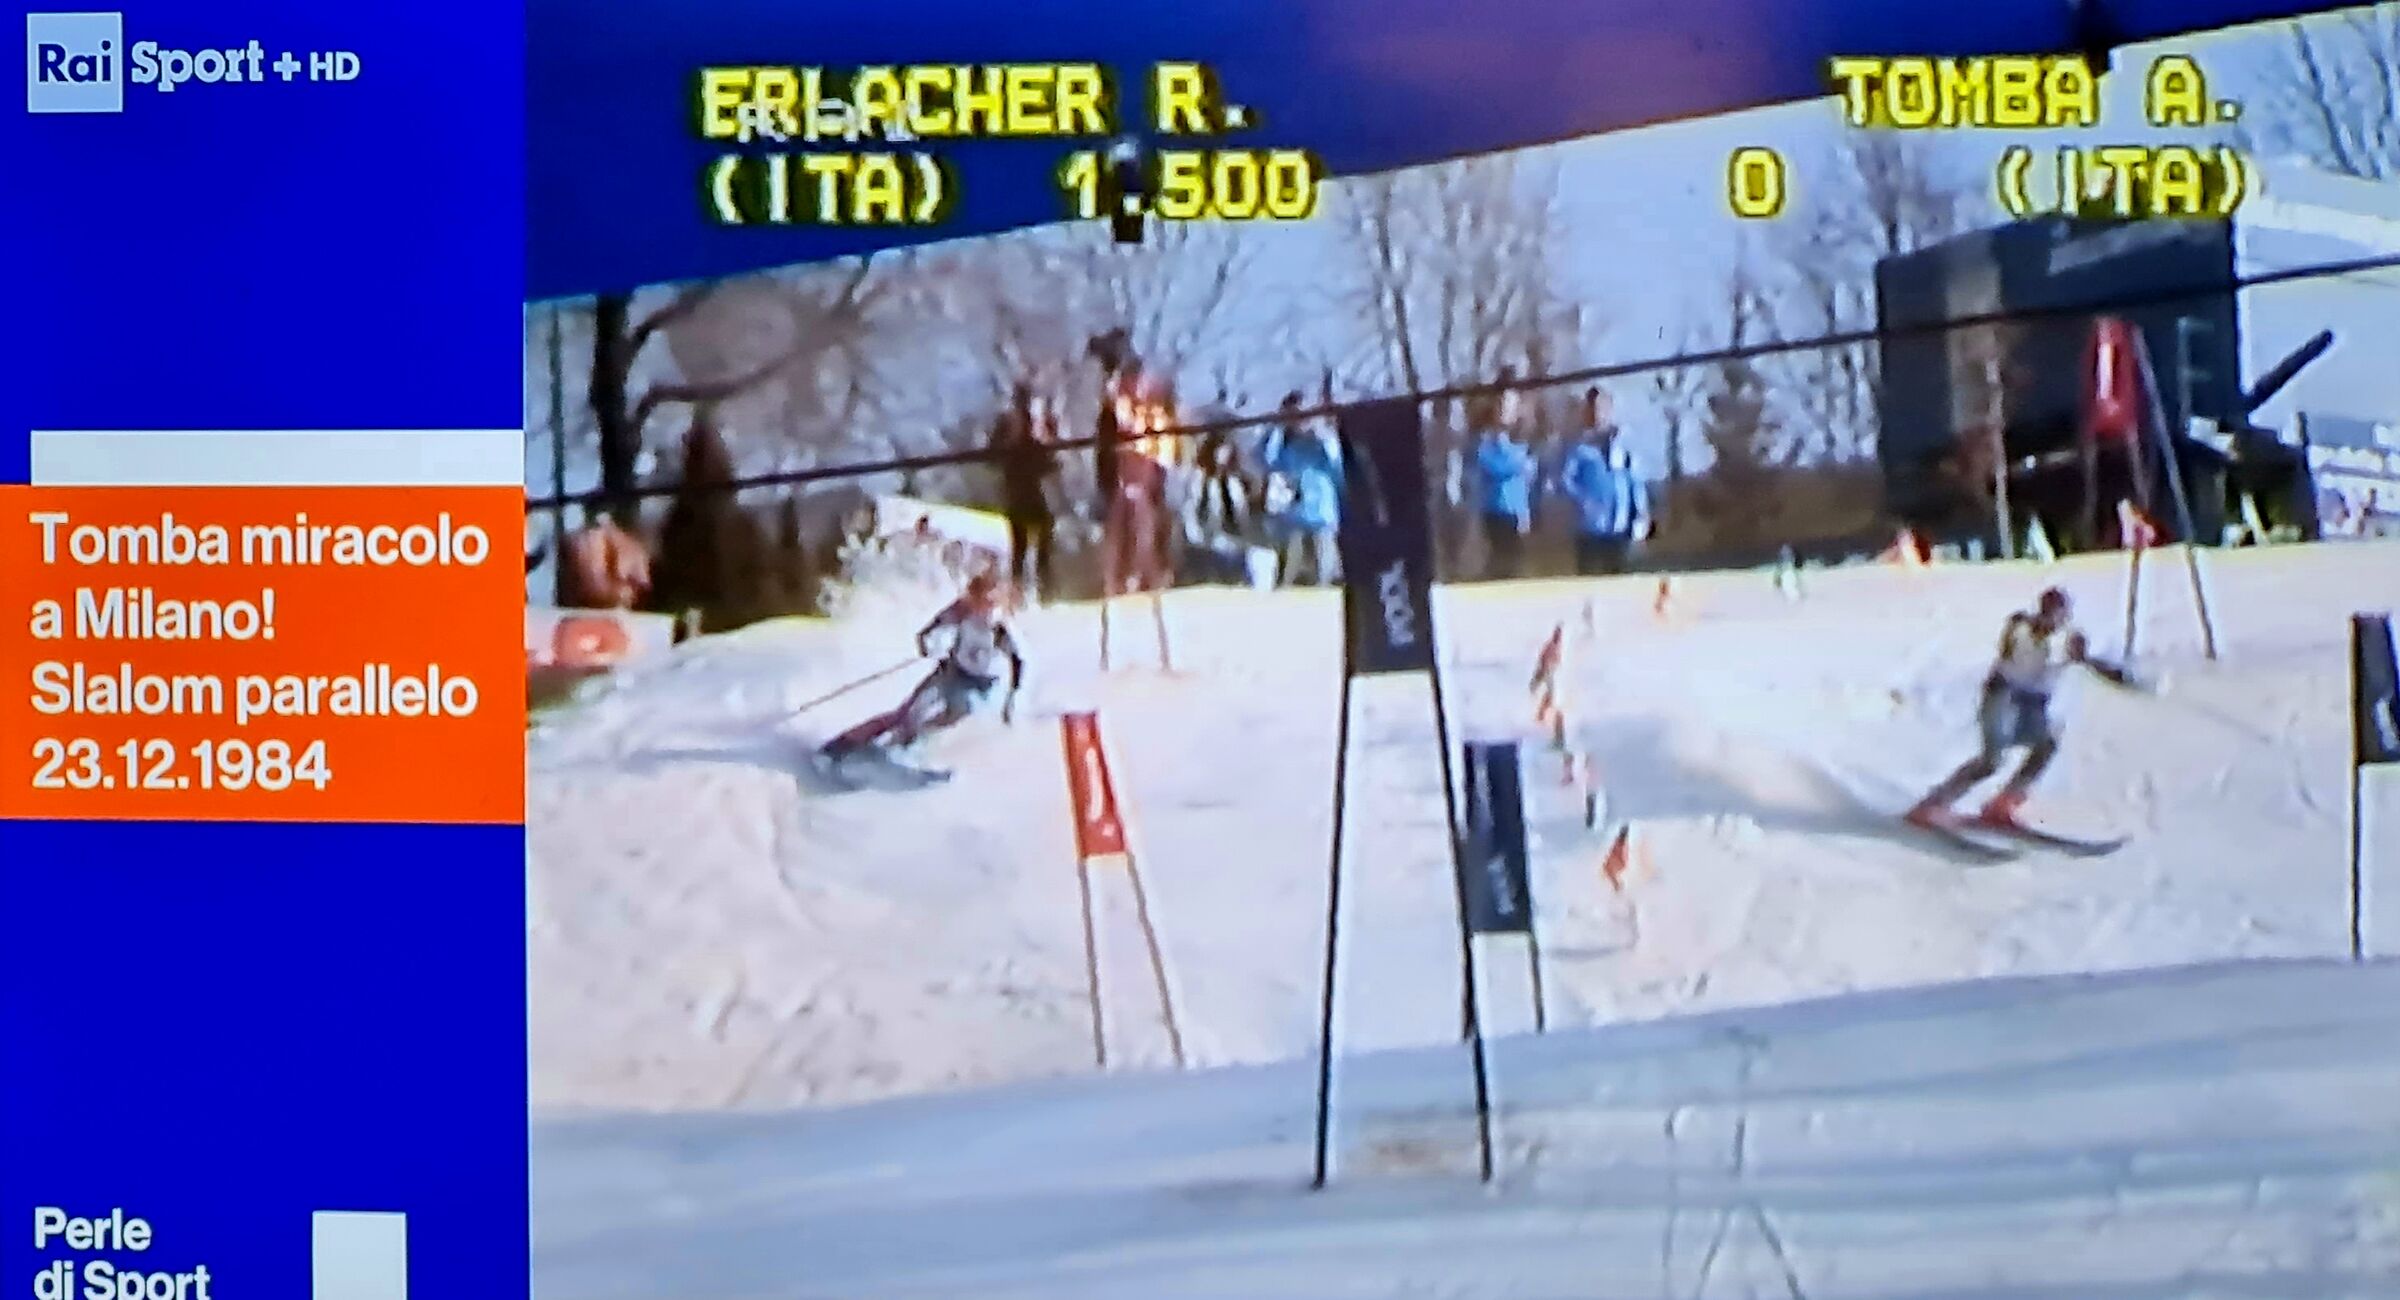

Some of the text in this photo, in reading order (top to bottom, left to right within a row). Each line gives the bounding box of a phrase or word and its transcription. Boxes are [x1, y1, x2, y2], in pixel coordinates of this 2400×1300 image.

[38, 40, 112, 82] Rai
[131, 40, 264, 92] Sport
[309, 51, 361, 81] HD
[1832, 56, 2240, 127] TOMBA A.
[702, 62, 1247, 135] ERLACHER R.
[711, 150, 1312, 223] (ITA) 1.500
[2000, 147, 2243, 216] (ITA)
[30, 512, 489, 565] Tomba miracolo
[30, 588, 275, 639] a Milano!
[32, 662, 479, 725] Slalom parallelo
[32, 738, 332, 791] 23.12.1984
[35, 1206, 152, 1251] Perle
[34, 1260, 211, 1300] di Sport
